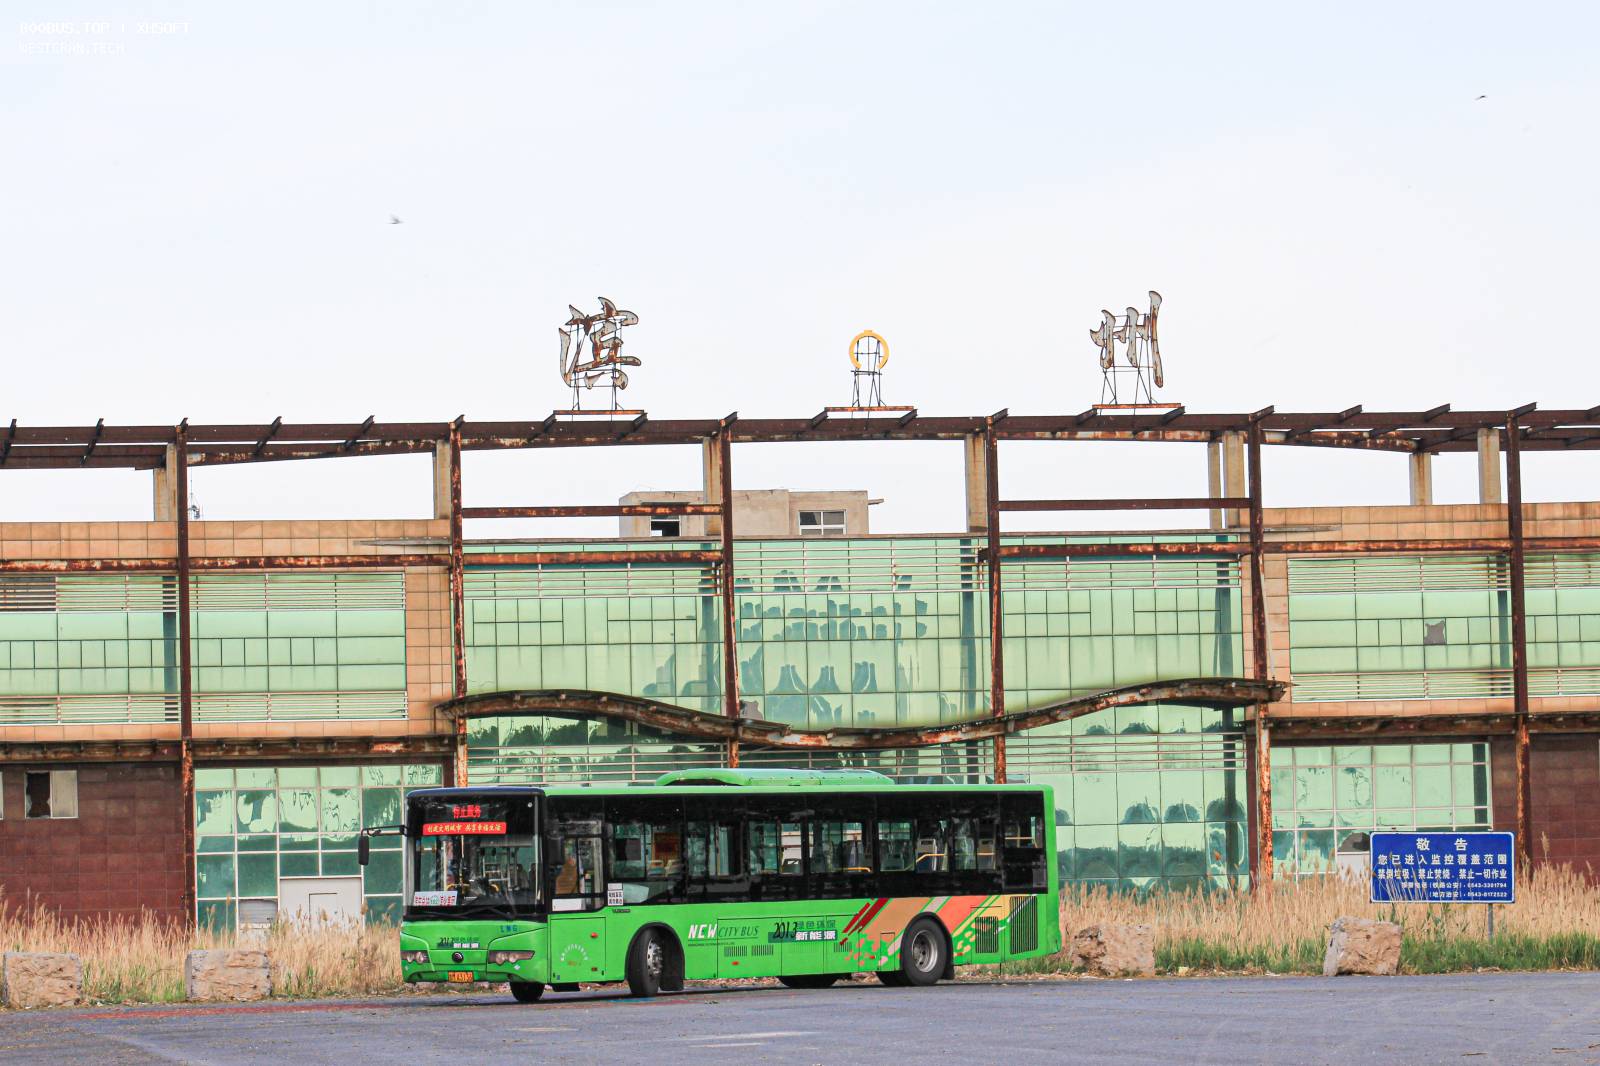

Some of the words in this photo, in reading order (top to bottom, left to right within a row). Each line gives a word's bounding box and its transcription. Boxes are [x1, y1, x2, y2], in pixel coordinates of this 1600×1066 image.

[1416, 838, 1468, 851] 敬告
[1378, 854, 1507, 865] 您已进入监控覆盖范围
[688, 924, 717, 939] NEW
[718, 926, 740, 937] CITY
[741, 925, 760, 936] BUS
[773, 922, 798, 939] 2013
[795, 930, 836, 941] 新能源
